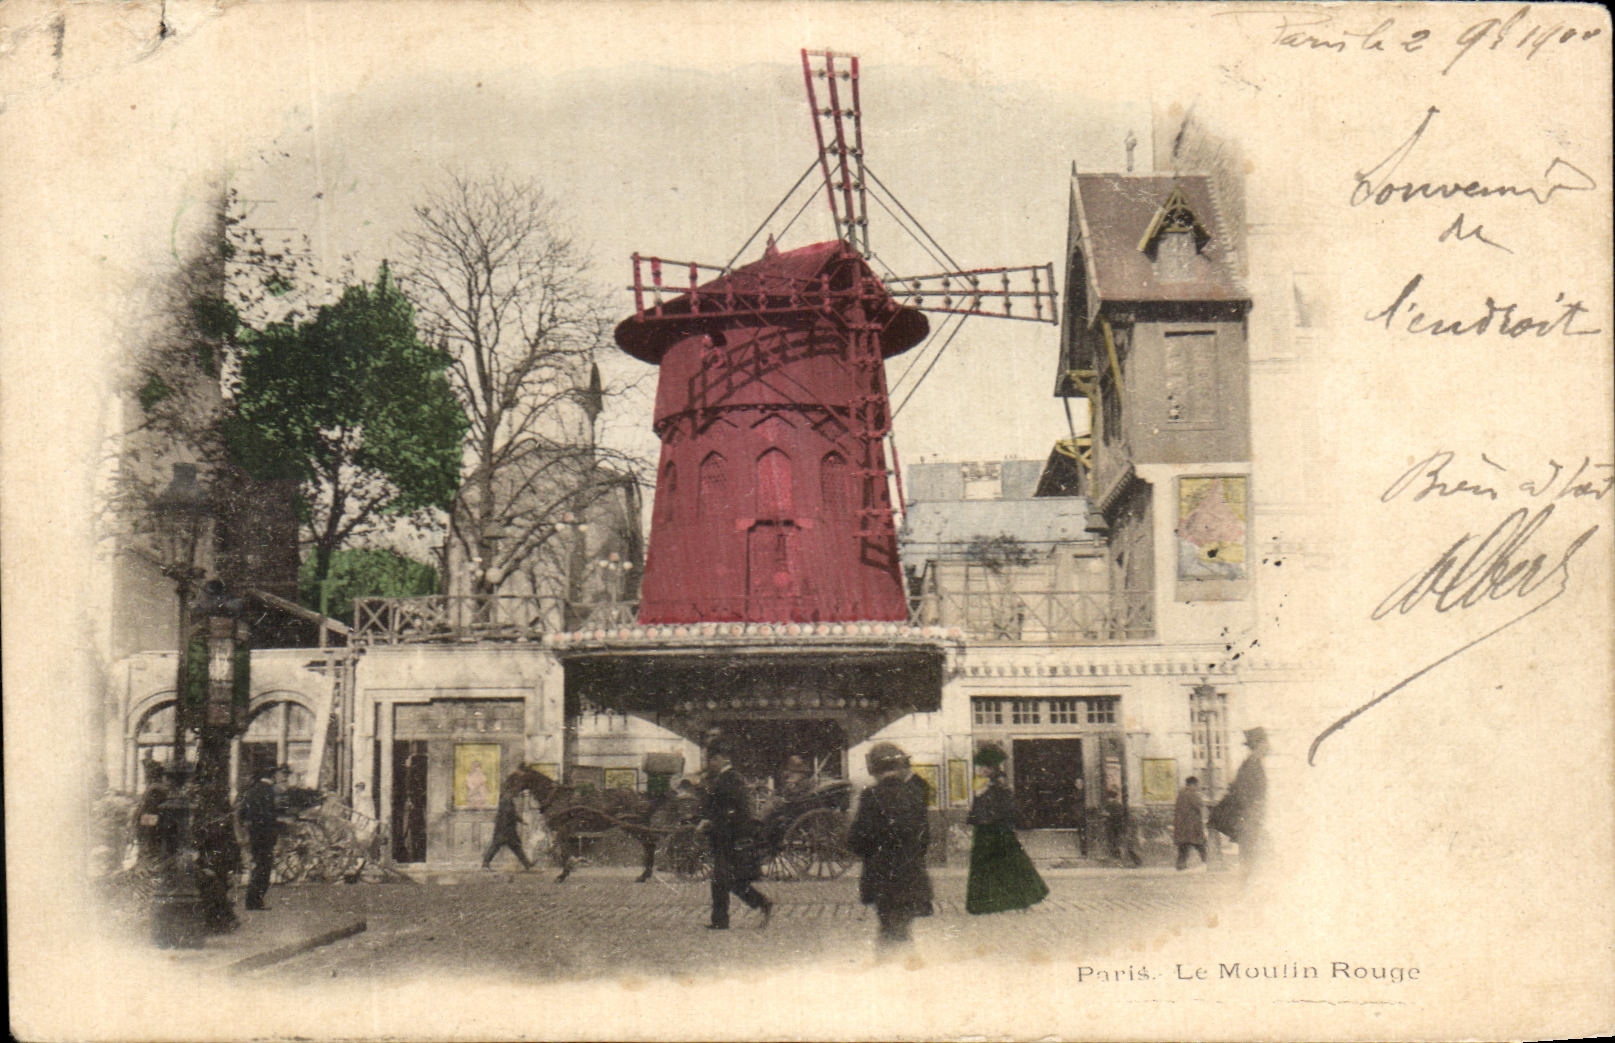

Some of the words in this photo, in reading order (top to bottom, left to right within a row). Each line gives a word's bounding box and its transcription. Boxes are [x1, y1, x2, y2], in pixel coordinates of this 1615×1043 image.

[1400, 29, 1431, 53] 2
[1350, 106, 1597, 206] Souvenir
[1365, 273, 1602, 338] l'endroit
